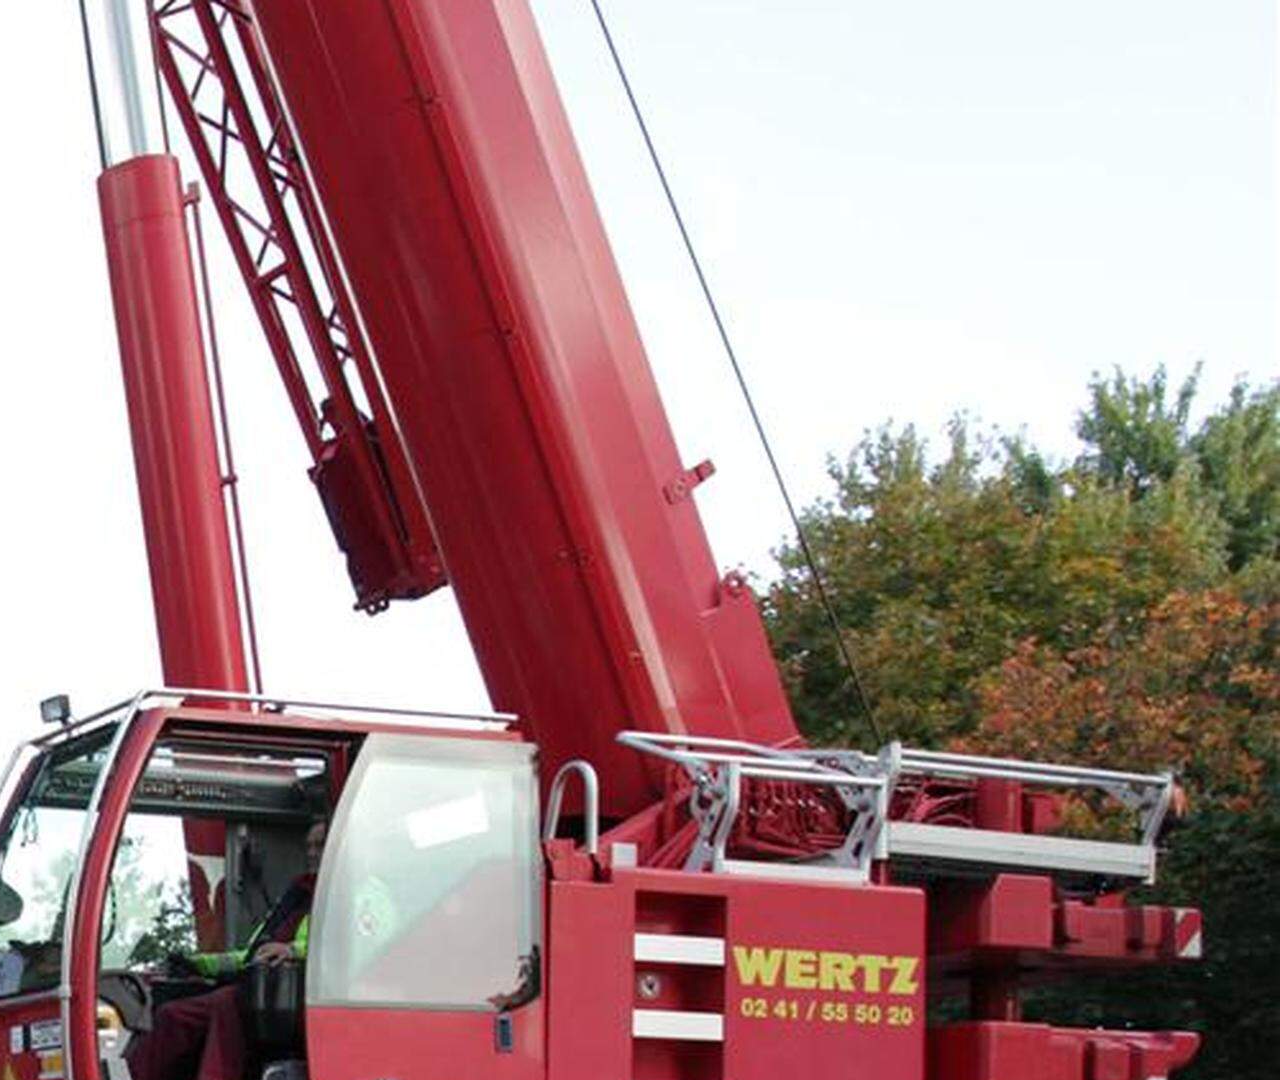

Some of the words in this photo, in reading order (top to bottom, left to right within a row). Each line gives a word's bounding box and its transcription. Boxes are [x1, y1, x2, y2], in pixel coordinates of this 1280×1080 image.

[733, 946, 919, 995] WERTZ
[741, 998, 768, 1018] 02
[773, 999, 799, 1019] 41
[821, 1002, 848, 1021] 55
[854, 1003, 881, 1023] 50
[887, 1006, 914, 1025] 20
